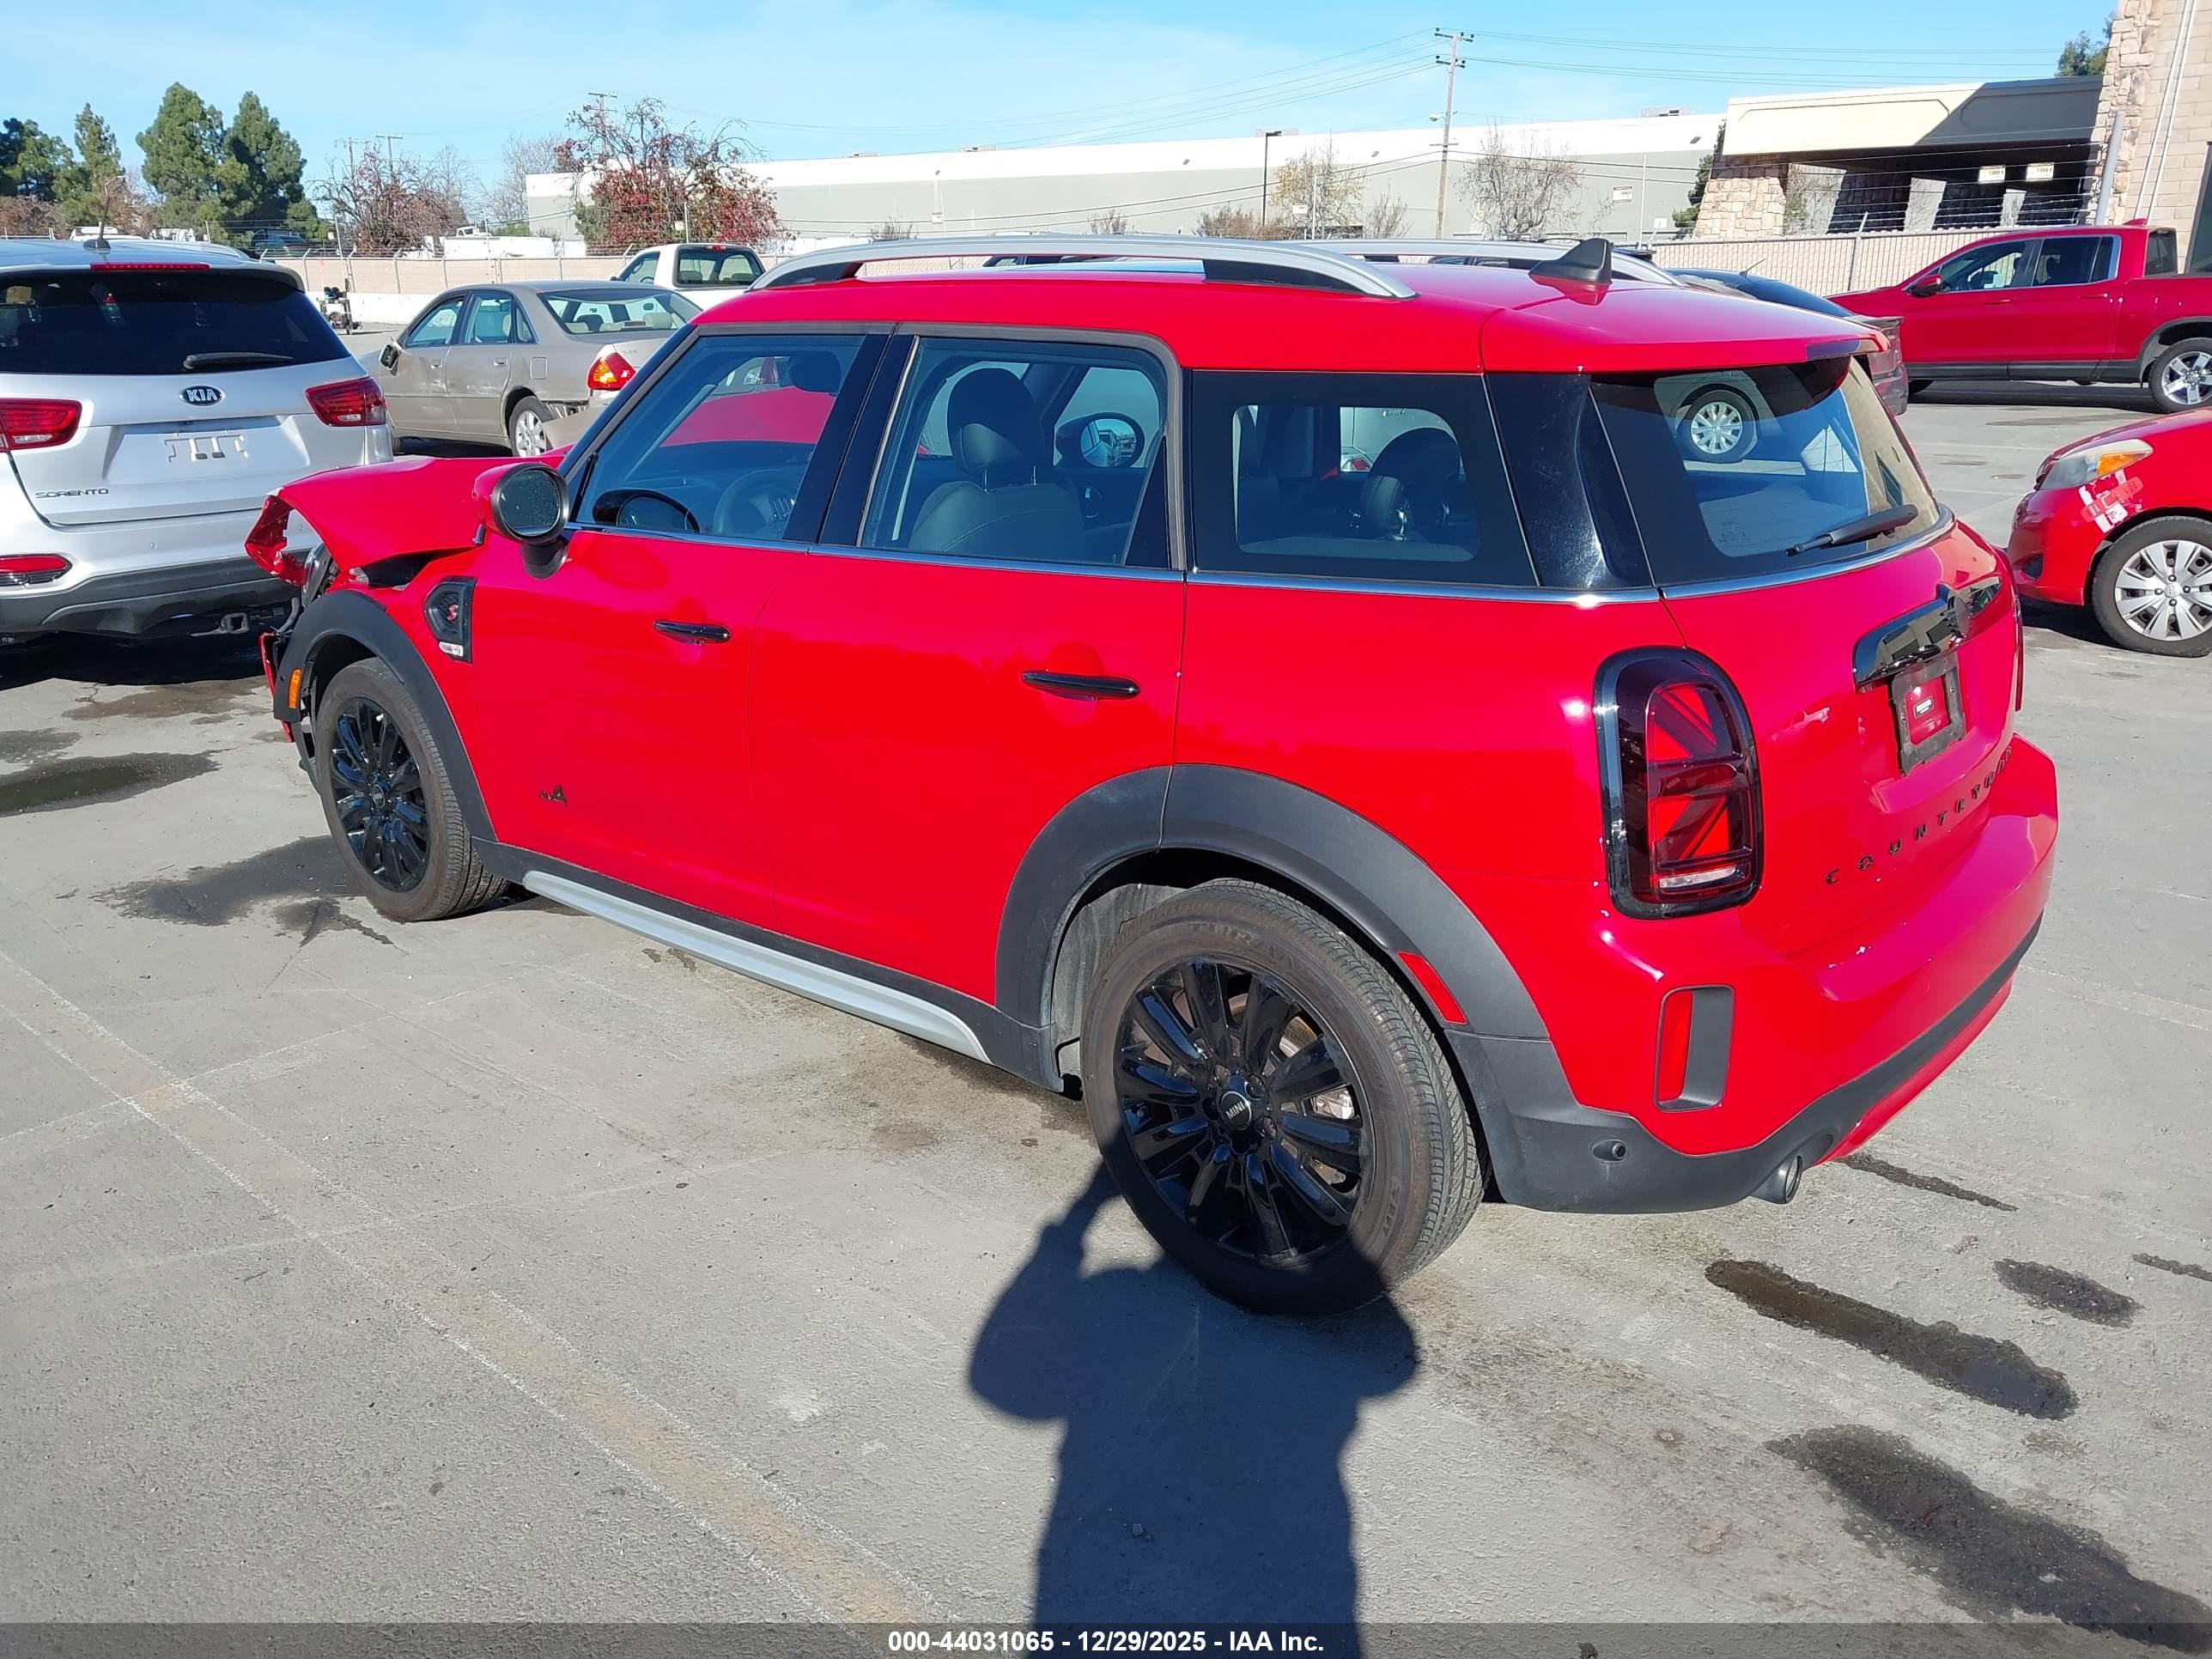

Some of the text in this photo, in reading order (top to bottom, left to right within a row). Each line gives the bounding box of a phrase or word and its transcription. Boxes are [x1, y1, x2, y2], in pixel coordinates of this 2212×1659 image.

[186, 389, 217, 402] KIA
[35, 488, 109, 499] SORENTO
[1225, 1101, 1245, 1120] MINI
